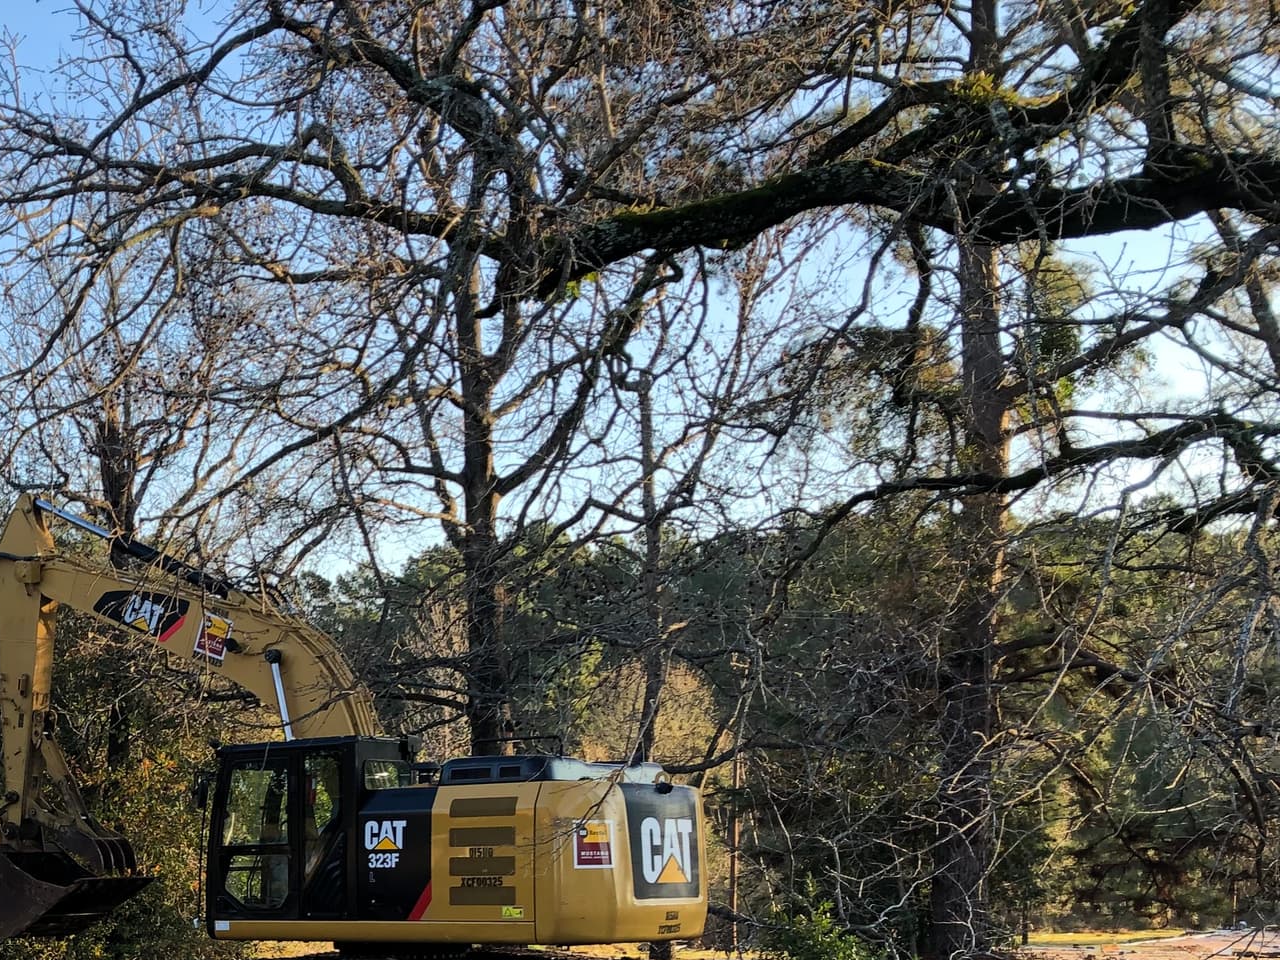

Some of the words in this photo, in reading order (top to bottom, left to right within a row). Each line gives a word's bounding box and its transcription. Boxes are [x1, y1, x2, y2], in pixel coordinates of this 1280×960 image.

[124, 594, 164, 633] CAT
[364, 820, 407, 850] CAT
[640, 817, 692, 884] CAT
[368, 853, 400, 868] 323F
